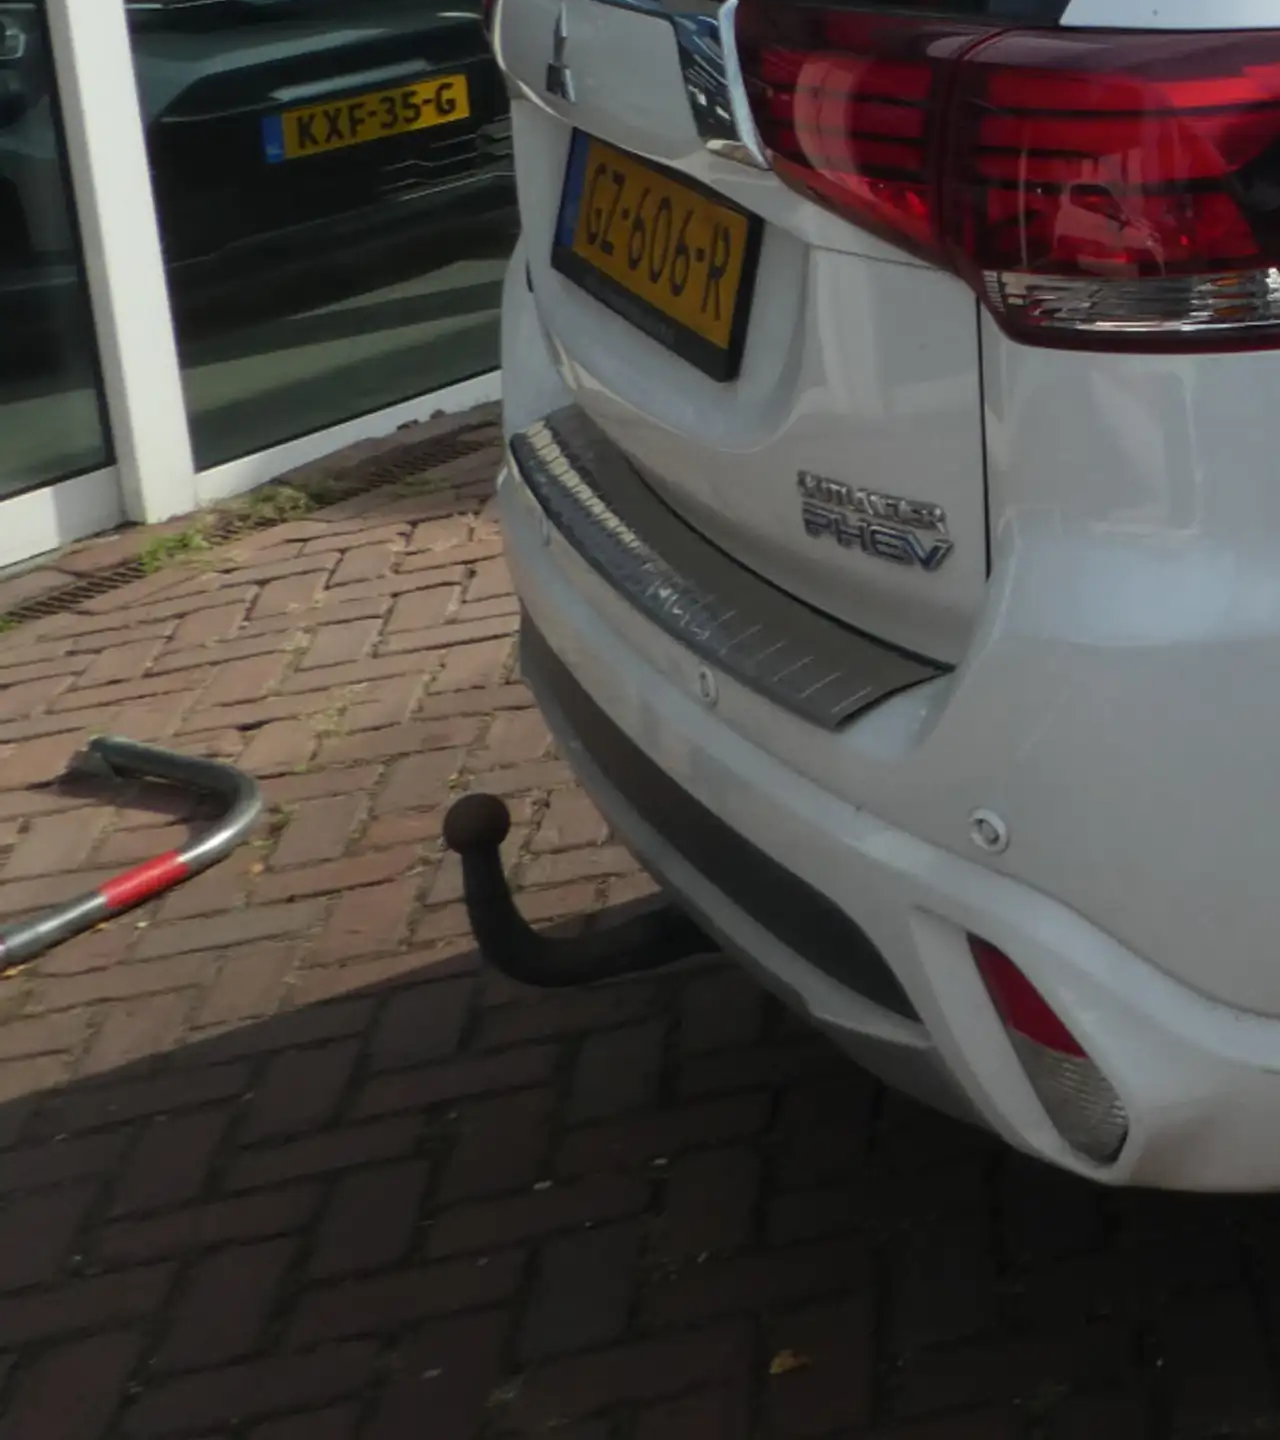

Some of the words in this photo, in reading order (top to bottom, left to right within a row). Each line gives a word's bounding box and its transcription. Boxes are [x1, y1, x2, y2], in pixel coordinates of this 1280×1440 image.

[295, 82, 458, 150] KXF-35-G
[586, 162, 732, 323] GZ-606-R
[802, 500, 955, 572] PHEV
